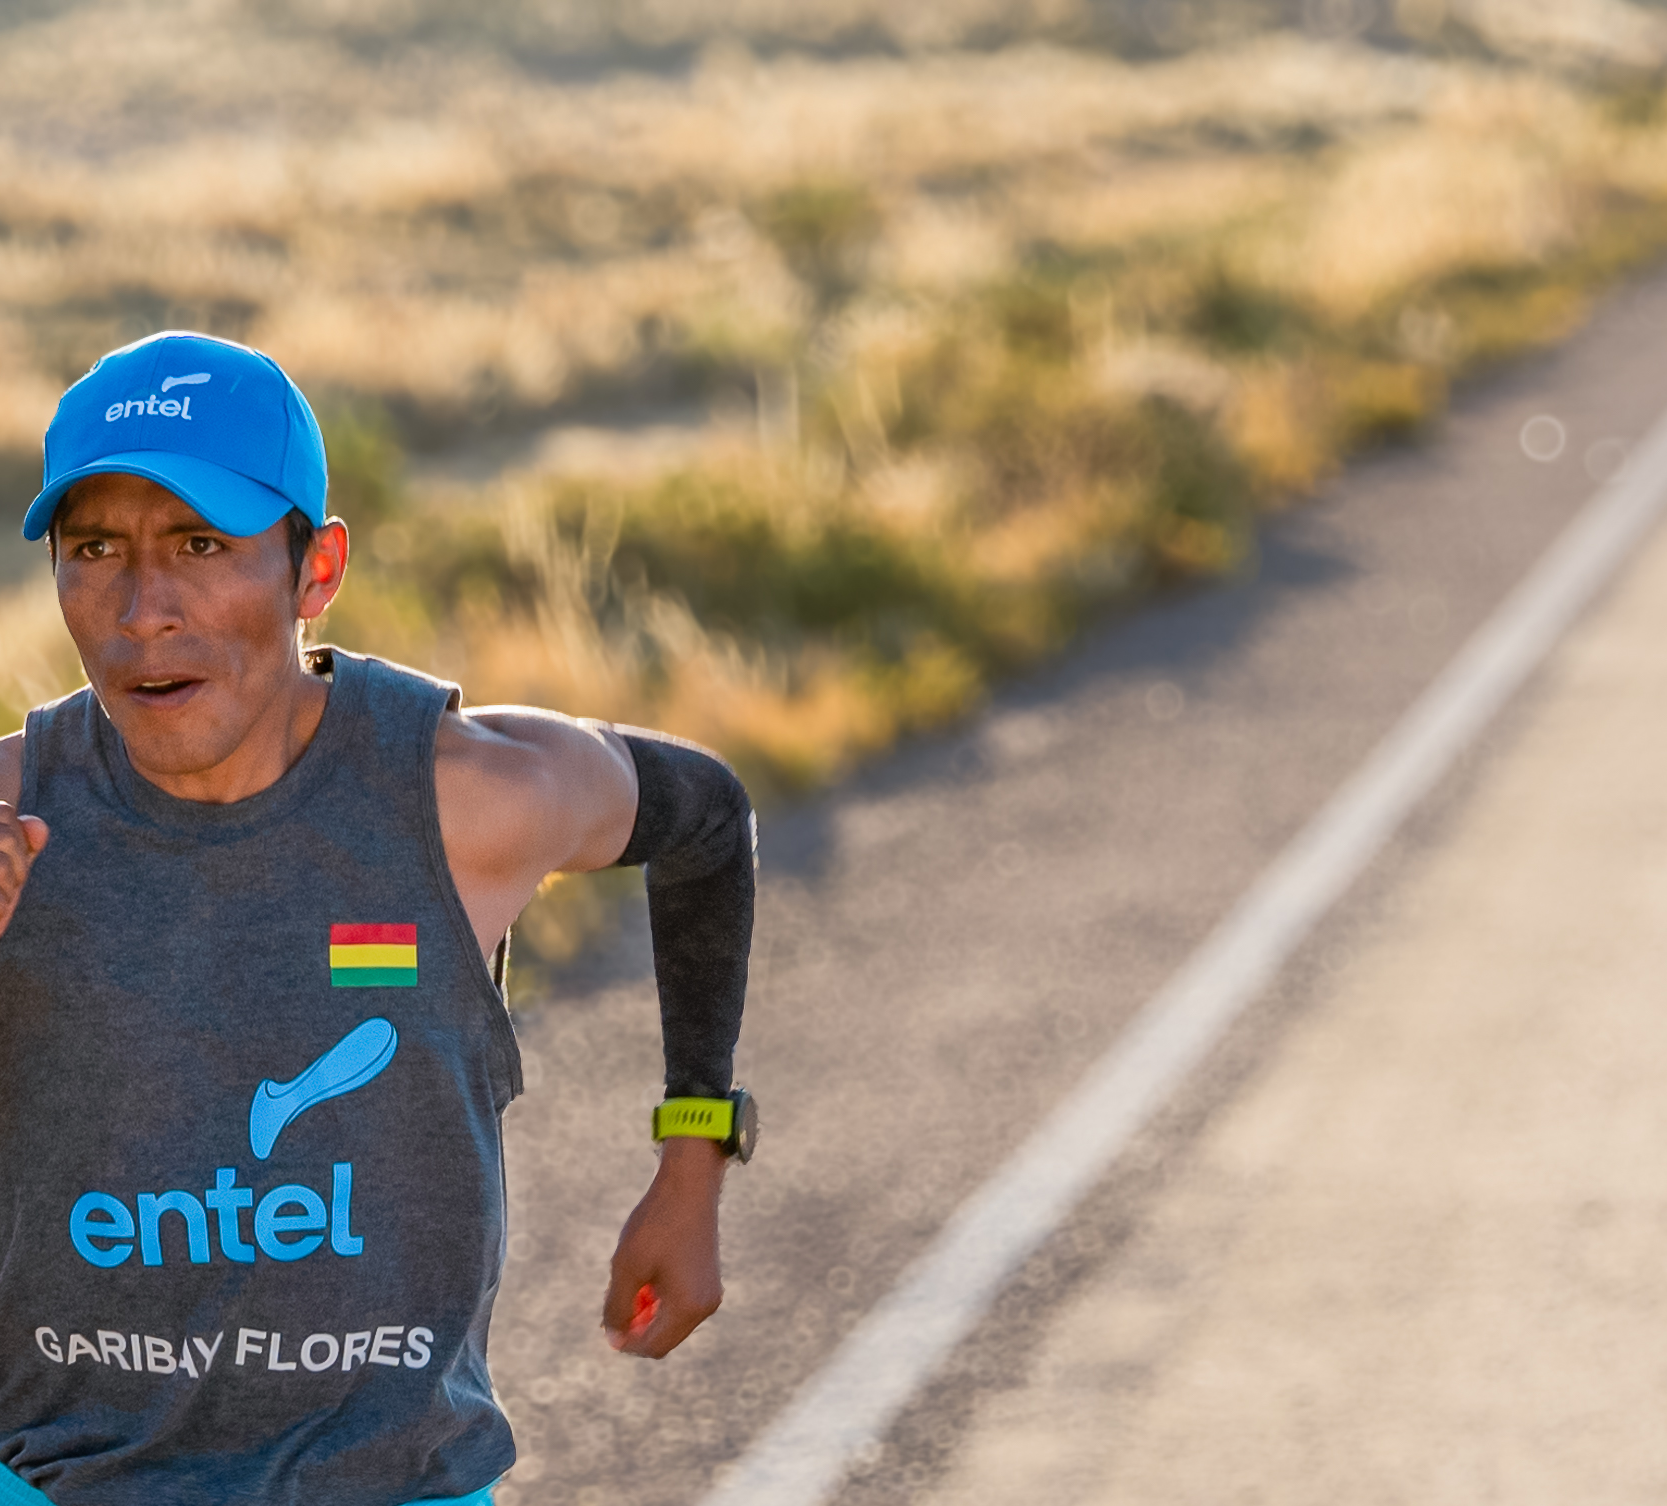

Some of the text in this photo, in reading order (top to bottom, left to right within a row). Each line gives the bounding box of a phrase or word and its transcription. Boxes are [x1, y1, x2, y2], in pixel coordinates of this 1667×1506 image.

[105, 394, 192, 422] entel
[69, 1162, 364, 1268] entel
[235, 1325, 434, 1372] FLORES
